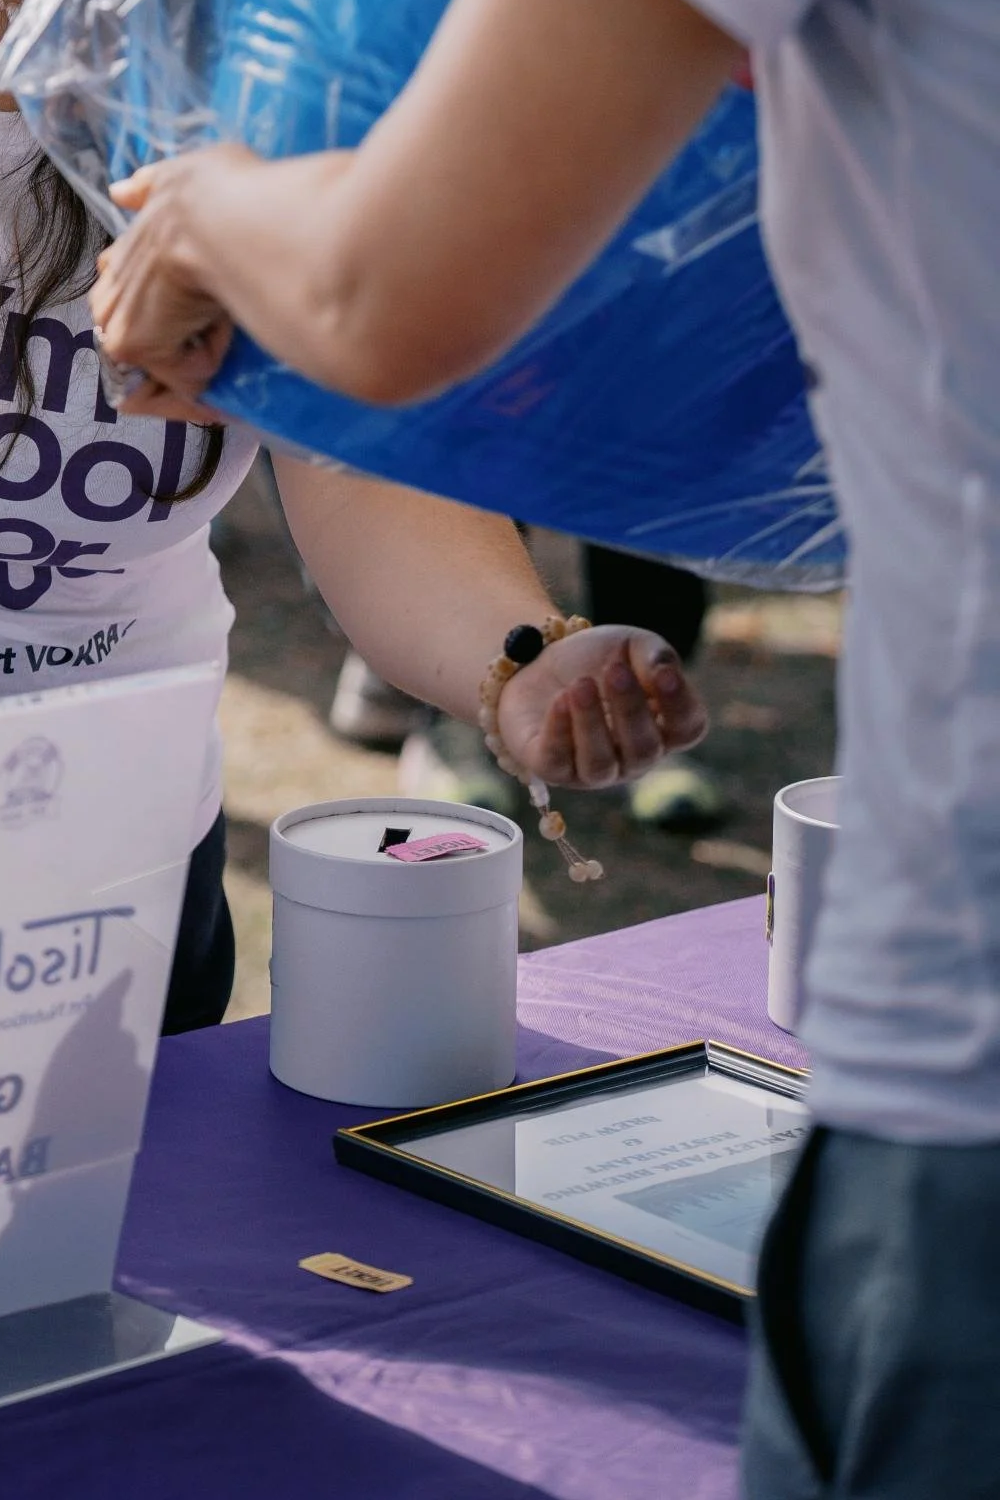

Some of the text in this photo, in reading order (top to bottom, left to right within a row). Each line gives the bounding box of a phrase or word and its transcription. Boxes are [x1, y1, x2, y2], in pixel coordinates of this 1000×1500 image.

[411, 839, 477, 857] TICKET
[542, 1115, 662, 1146] BREW PUB
[542, 1127, 806, 1201] TANLEY PARK BREWING
[584, 1131, 740, 1174] RESTAURANT
